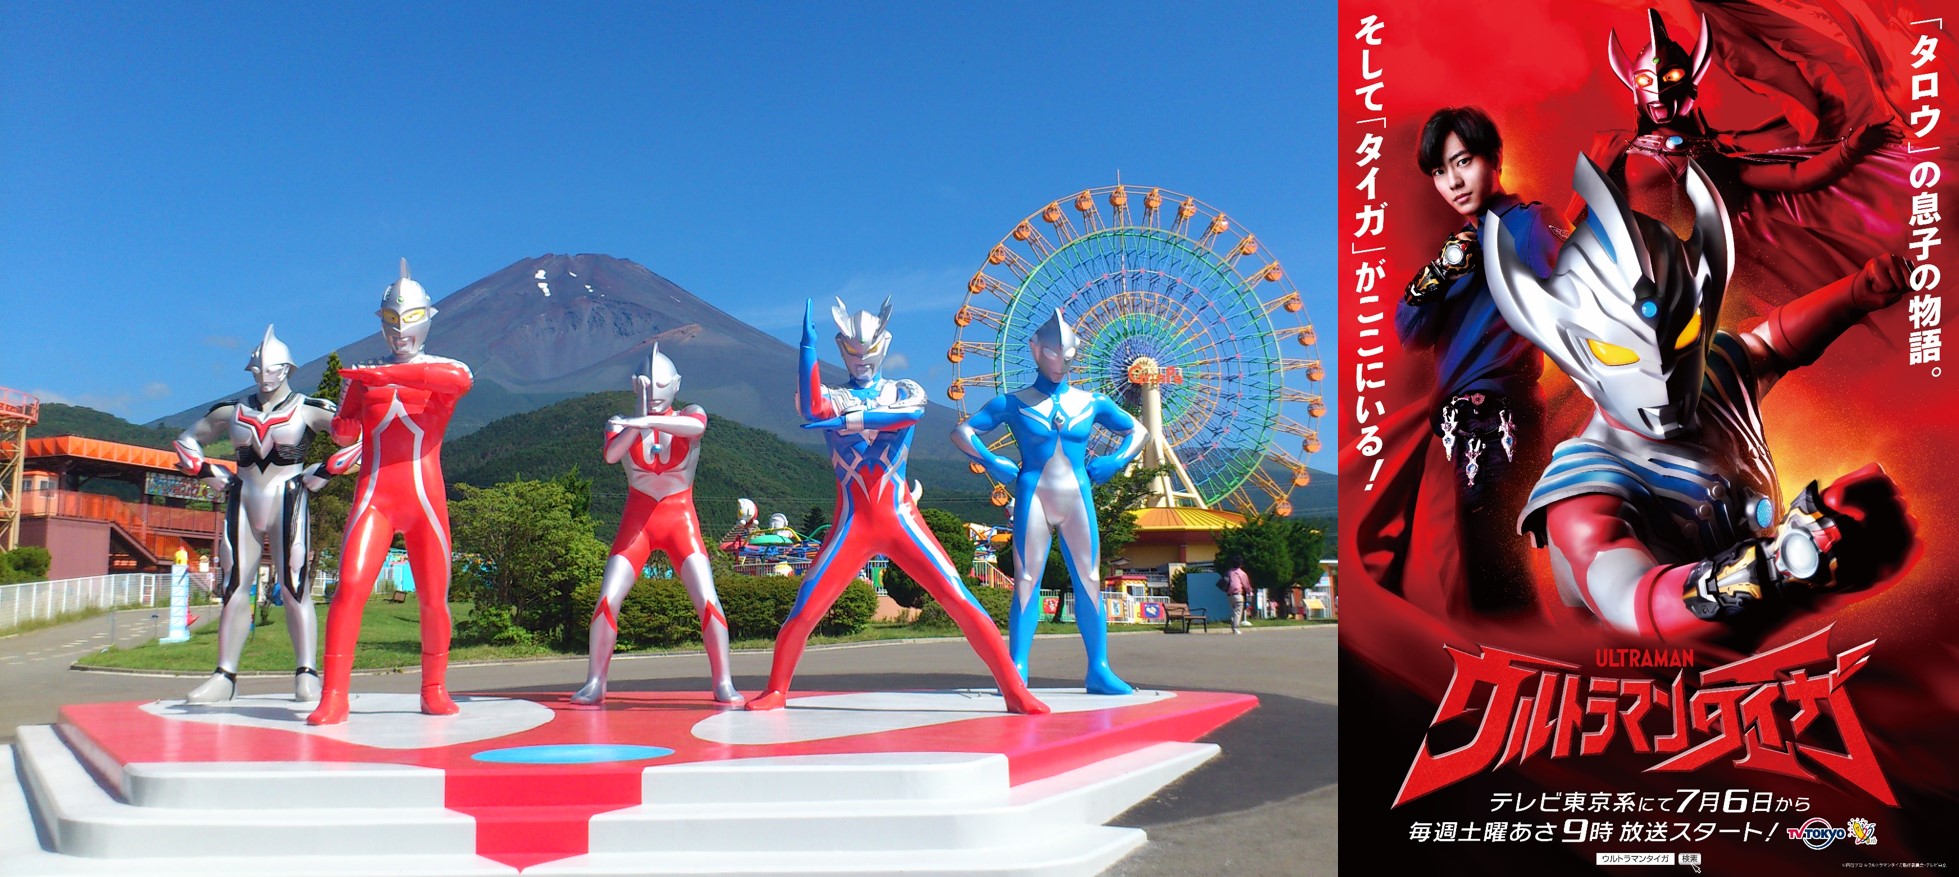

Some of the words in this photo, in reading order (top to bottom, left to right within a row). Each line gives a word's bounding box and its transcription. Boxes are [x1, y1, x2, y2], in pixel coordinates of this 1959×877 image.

[1908, 17, 1943, 378] 「タロウ」の息子の物語。
[1596, 648, 1694, 667] ULTRAMAN
[1391, 620, 1898, 809] ウルトラマンタイガ
[1490, 789, 1810, 813] テレビ東京系にて7月6日から
[1602, 854, 1669, 863] ウルトラマンタイガ
[1682, 854, 1698, 863] 検索
